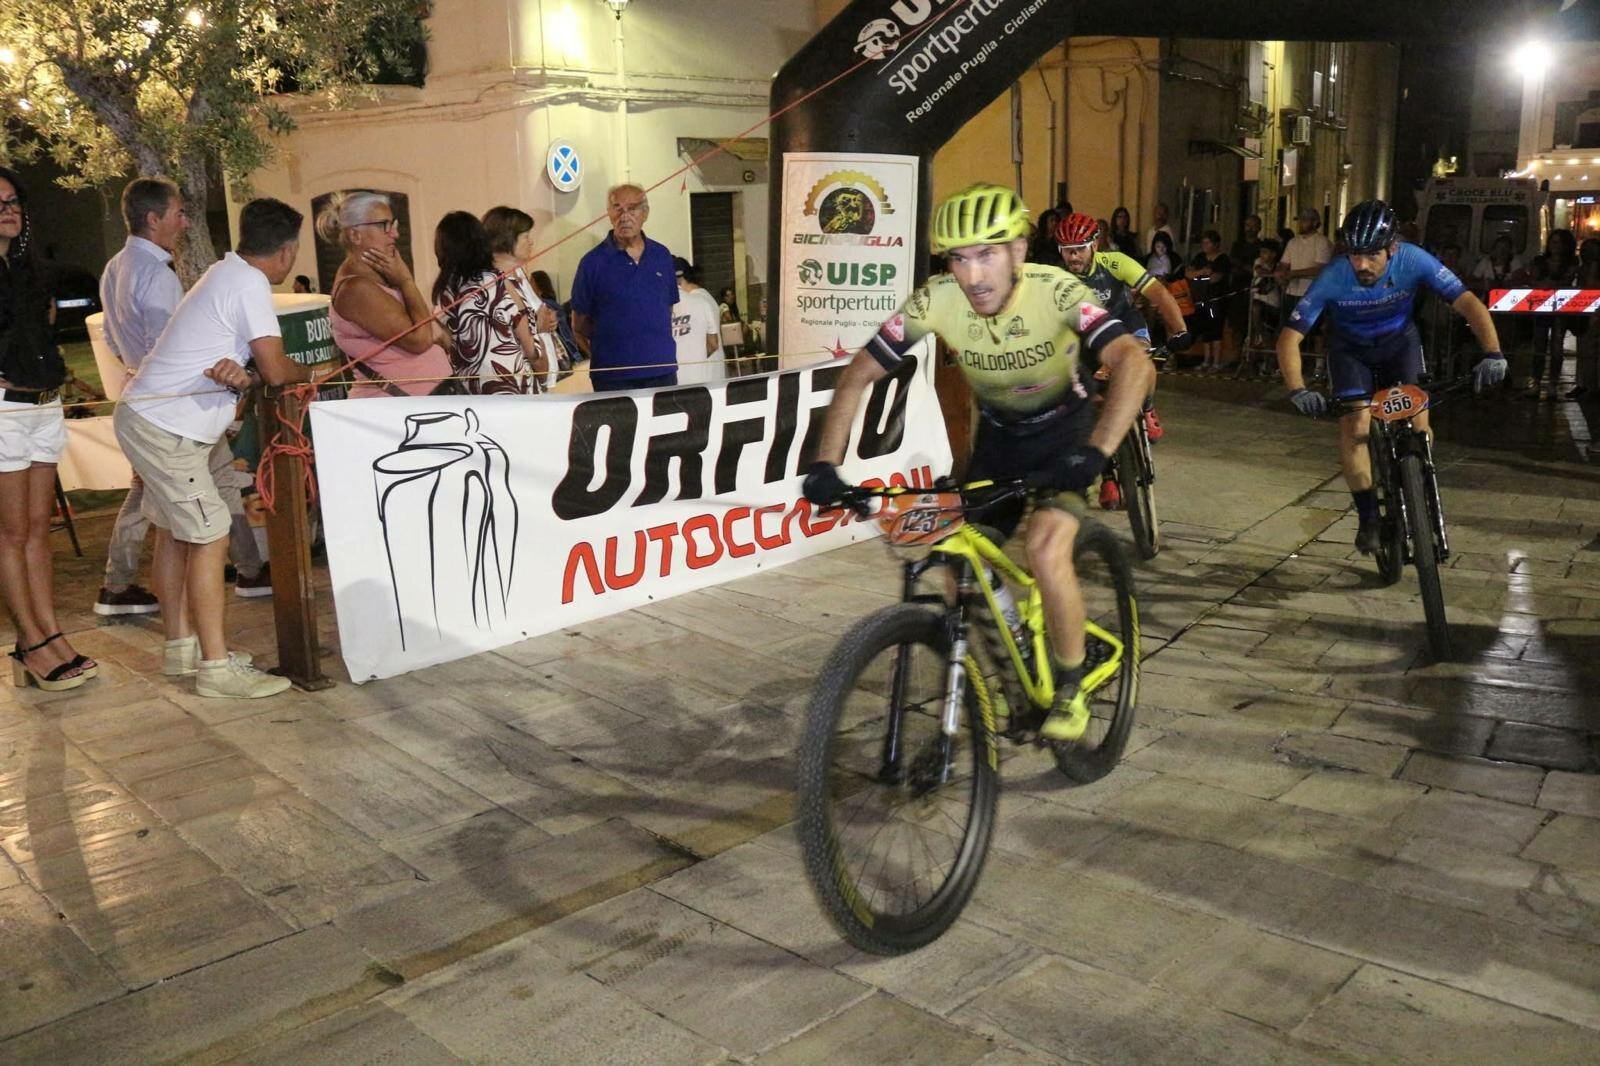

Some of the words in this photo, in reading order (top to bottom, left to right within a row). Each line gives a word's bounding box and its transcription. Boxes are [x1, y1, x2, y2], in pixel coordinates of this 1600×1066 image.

[905, 71, 963, 124] Regionale
[961, 39, 999, 75] Puglia
[826, 262, 897, 287] UISP
[796, 294, 897, 315] sportpertutti
[800, 317, 833, 327] Regionale
[834, 319, 857, 328] Puglia
[862, 320, 884, 328] Ciclis
[306, 351, 315, 364] DI
[964, 340, 1056, 371] CALDOROSSO
[1382, 395, 1412, 415] 356
[561, 464, 933, 605] AUTOCCASO
